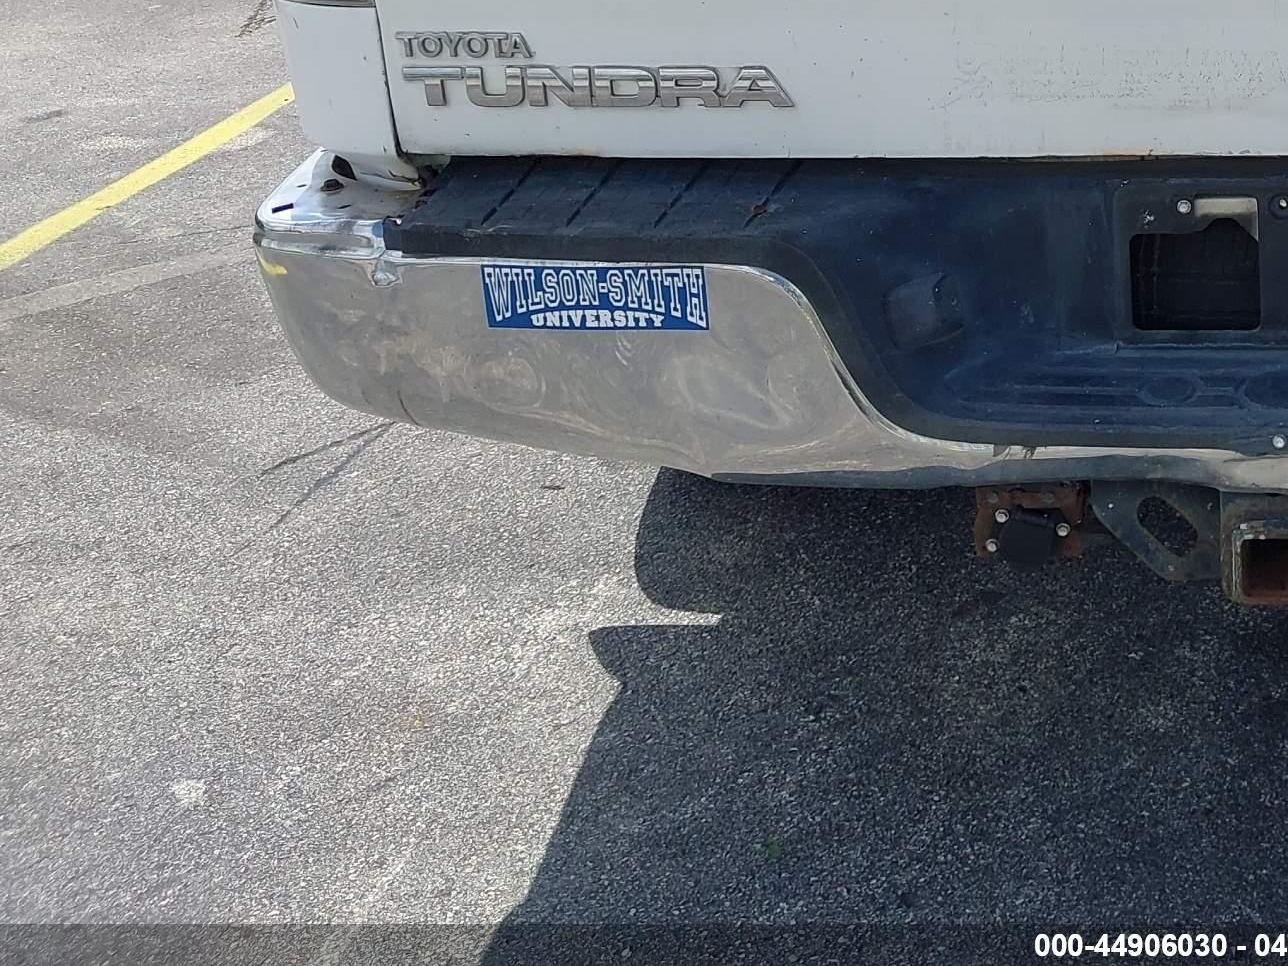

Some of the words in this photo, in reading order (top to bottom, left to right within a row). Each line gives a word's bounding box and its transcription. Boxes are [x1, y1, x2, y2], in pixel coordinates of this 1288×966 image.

[396, 32, 535, 58] TOYOTA
[402, 65, 796, 108] TUNDRA
[484, 267, 707, 328] WILSON-SMITH
[531, 309, 664, 327] UNIVERSITY
